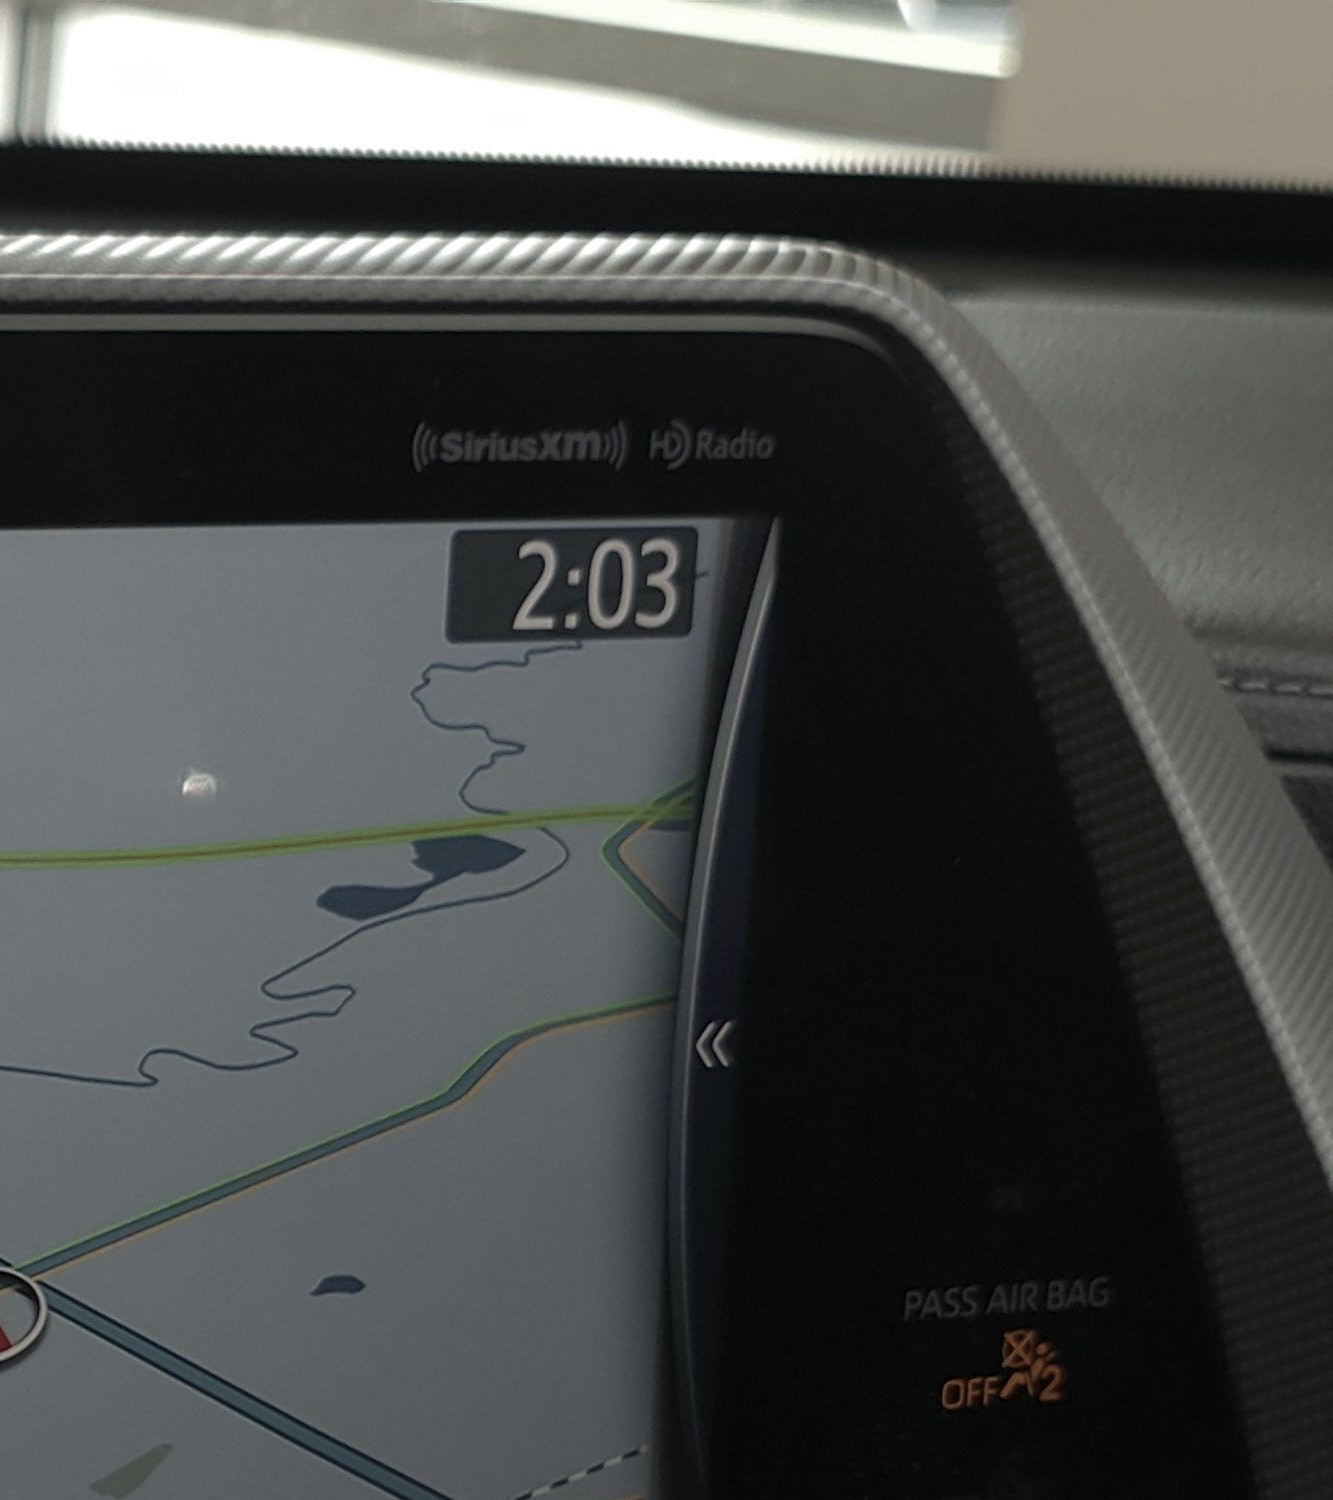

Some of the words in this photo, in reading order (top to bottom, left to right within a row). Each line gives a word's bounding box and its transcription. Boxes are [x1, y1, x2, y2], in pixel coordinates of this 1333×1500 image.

[695, 427, 775, 461] Radio
[511, 537, 680, 632] 2:03
[902, 1285, 981, 1323] PASS
[985, 1280, 1039, 1316] AIR
[1045, 1275, 1114, 1312] BAG
[940, 1375, 1002, 1411] OFF
